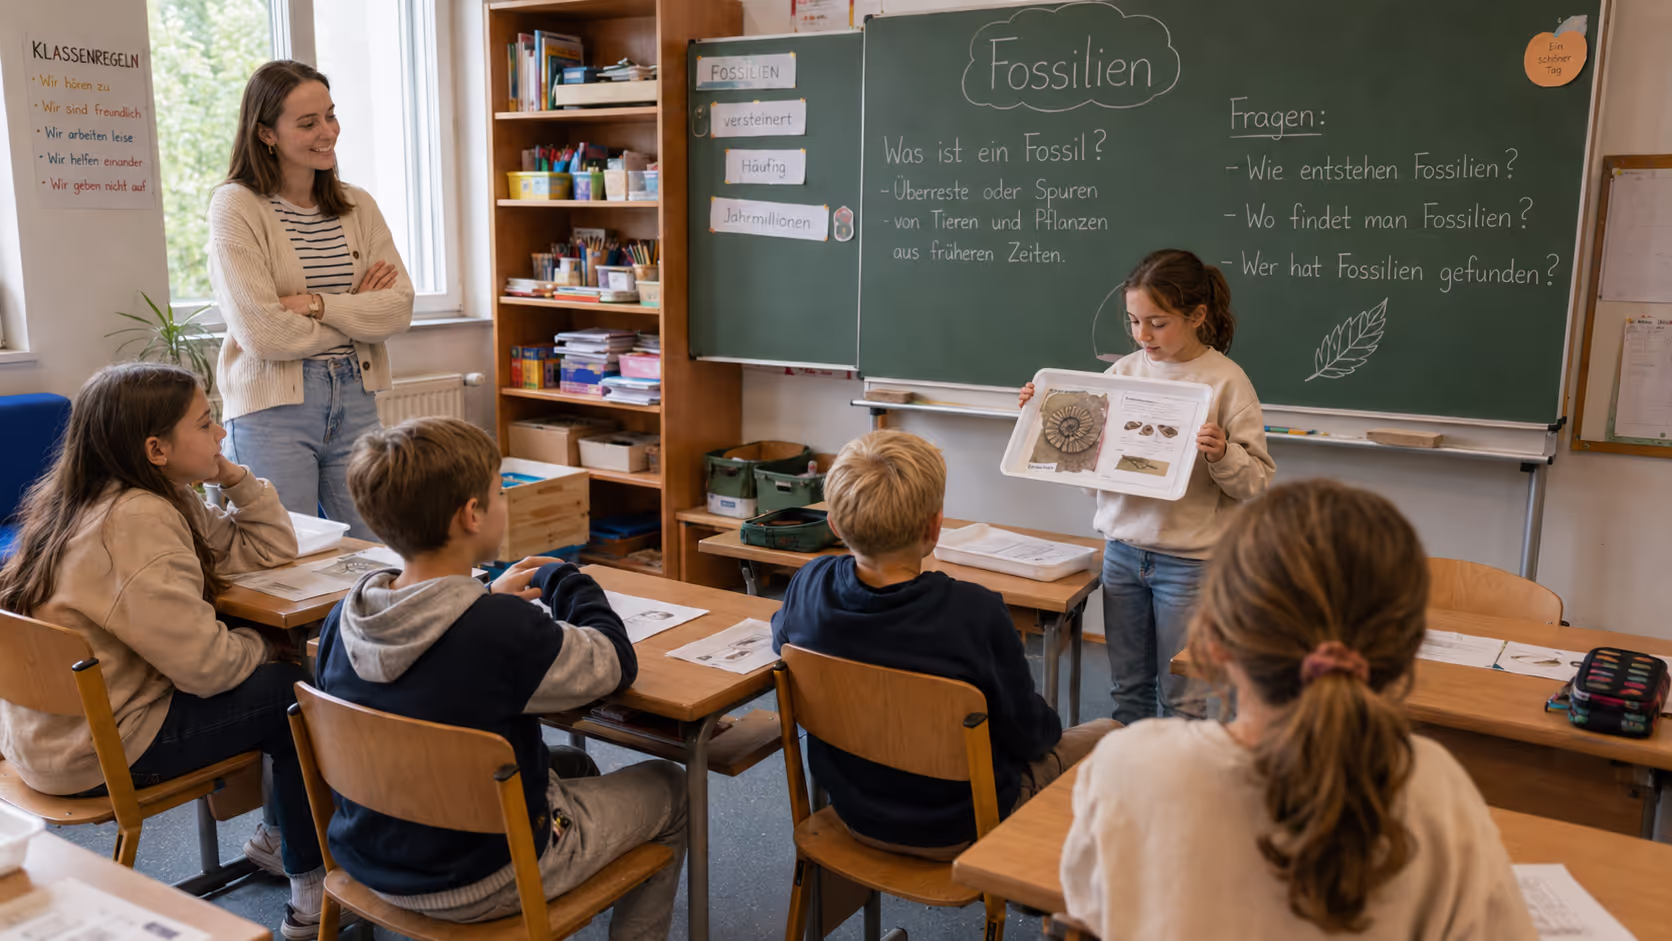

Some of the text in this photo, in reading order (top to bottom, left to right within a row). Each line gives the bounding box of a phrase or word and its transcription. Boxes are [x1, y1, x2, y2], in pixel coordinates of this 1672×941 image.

[32, 40, 139, 68] KLASSENREGELN
[1549, 42, 1563, 51] Ein
[711, 65, 779, 81] FOSSILIEN
[989, 35, 1152, 90] Fossilien
[1545, 66, 1561, 76] Tag
[40, 74, 110, 92] Wir hören zu
[42, 100, 141, 119] Wir sind freundlich
[724, 113, 792, 127] versteinert
[1230, 96, 1325, 140] Fragen:
[45, 126, 133, 143] Wir arbeiten leise
[884, 129, 1106, 164] Was ist ein Fossil?
[48, 152, 143, 168] Wir helfen einander
[742, 157, 786, 178] Häufig
[1247, 148, 1519, 180] Wie entstehen Fossilien?
[50, 178, 146, 195] Wir geben nicht auf
[983, 178, 1021, 200] oder
[1035, 179, 1098, 209] Spuren
[724, 208, 811, 230] Jahrmillionen
[895, 208, 1108, 230] von Tieren und Pflanzen
[1246, 197, 1533, 229] Wo findet man Fossilien?
[893, 240, 1066, 263] aus früheren Zeiten.
[1242, 250, 1560, 293] Wer hat Fossilien gefunden?
